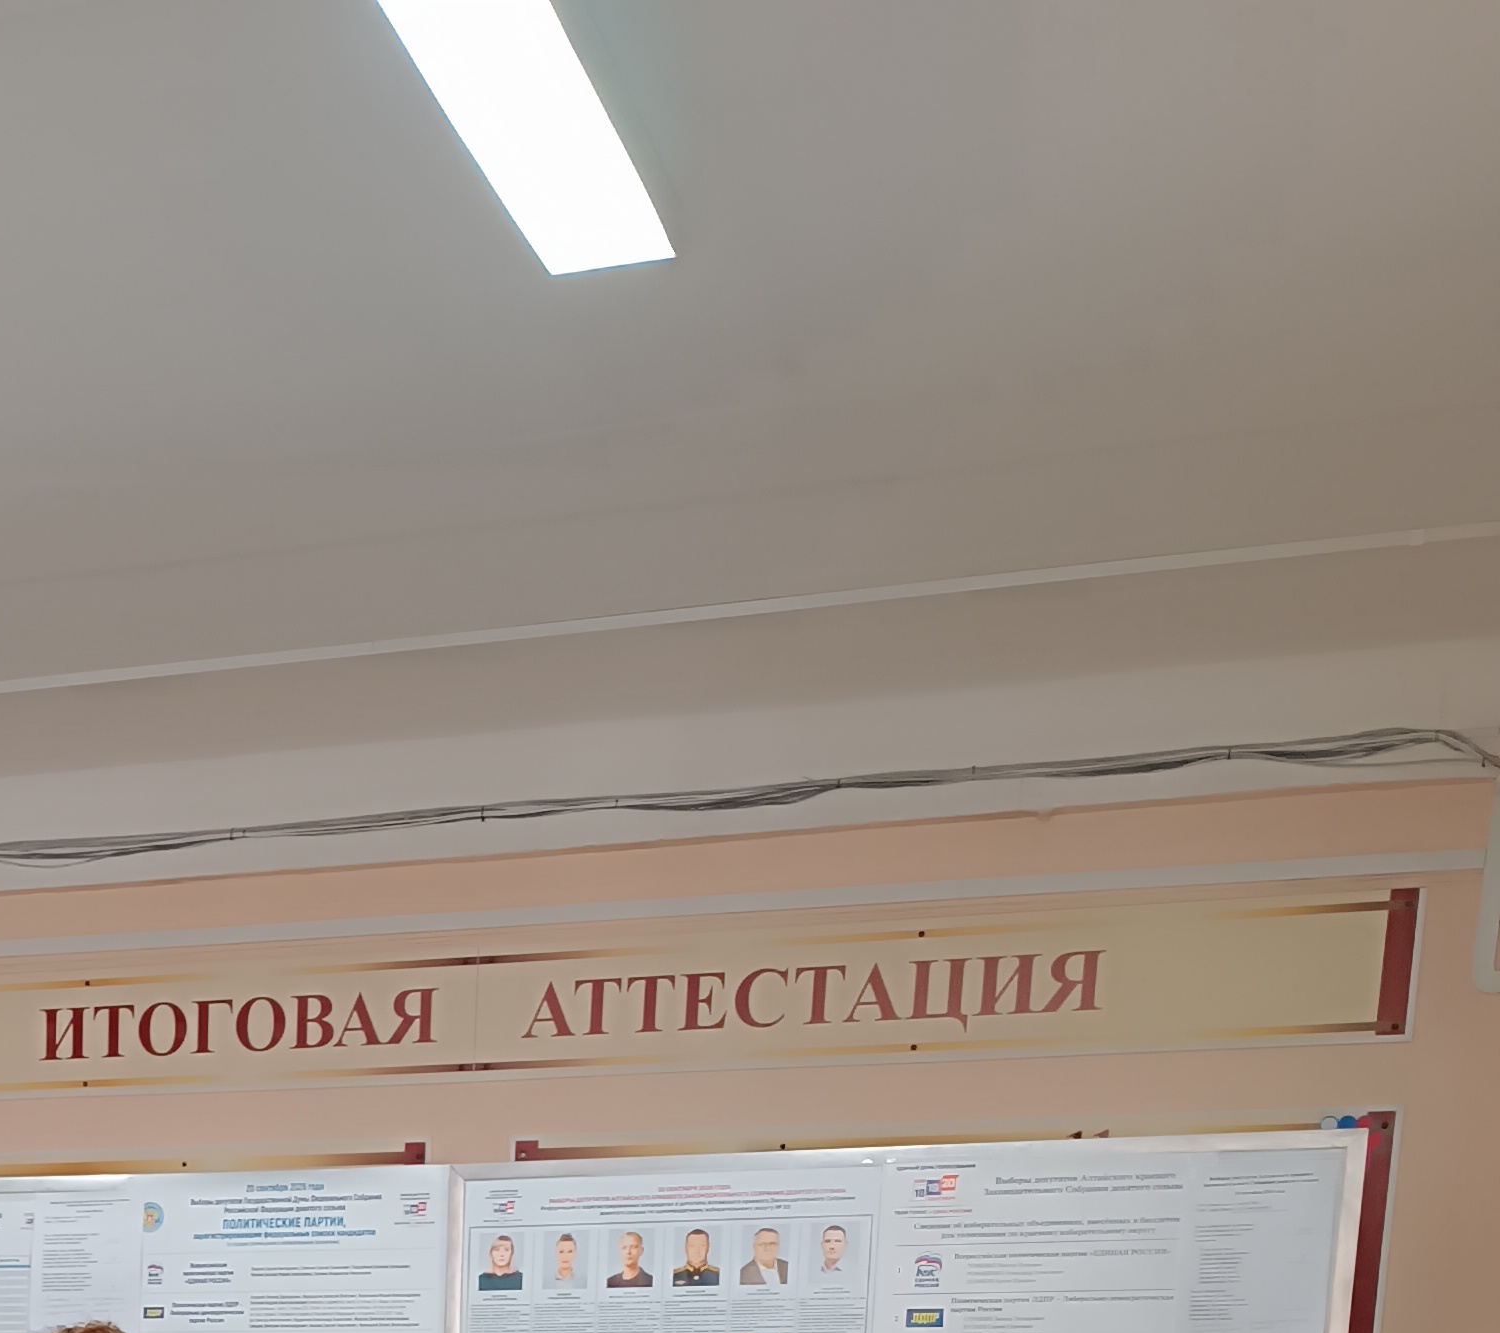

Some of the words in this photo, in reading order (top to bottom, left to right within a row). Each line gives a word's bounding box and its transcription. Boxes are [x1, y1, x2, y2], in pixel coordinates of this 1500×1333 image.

[41, 987, 438, 1062] ИТОГОВАЯ
[522, 949, 1104, 1038] АТТЕСТАЦИЯ
[222, 1216, 302, 1230] ПОЛИТИЧЕСКИЕ
[303, 1215, 347, 1229] ПАРТИИ,
